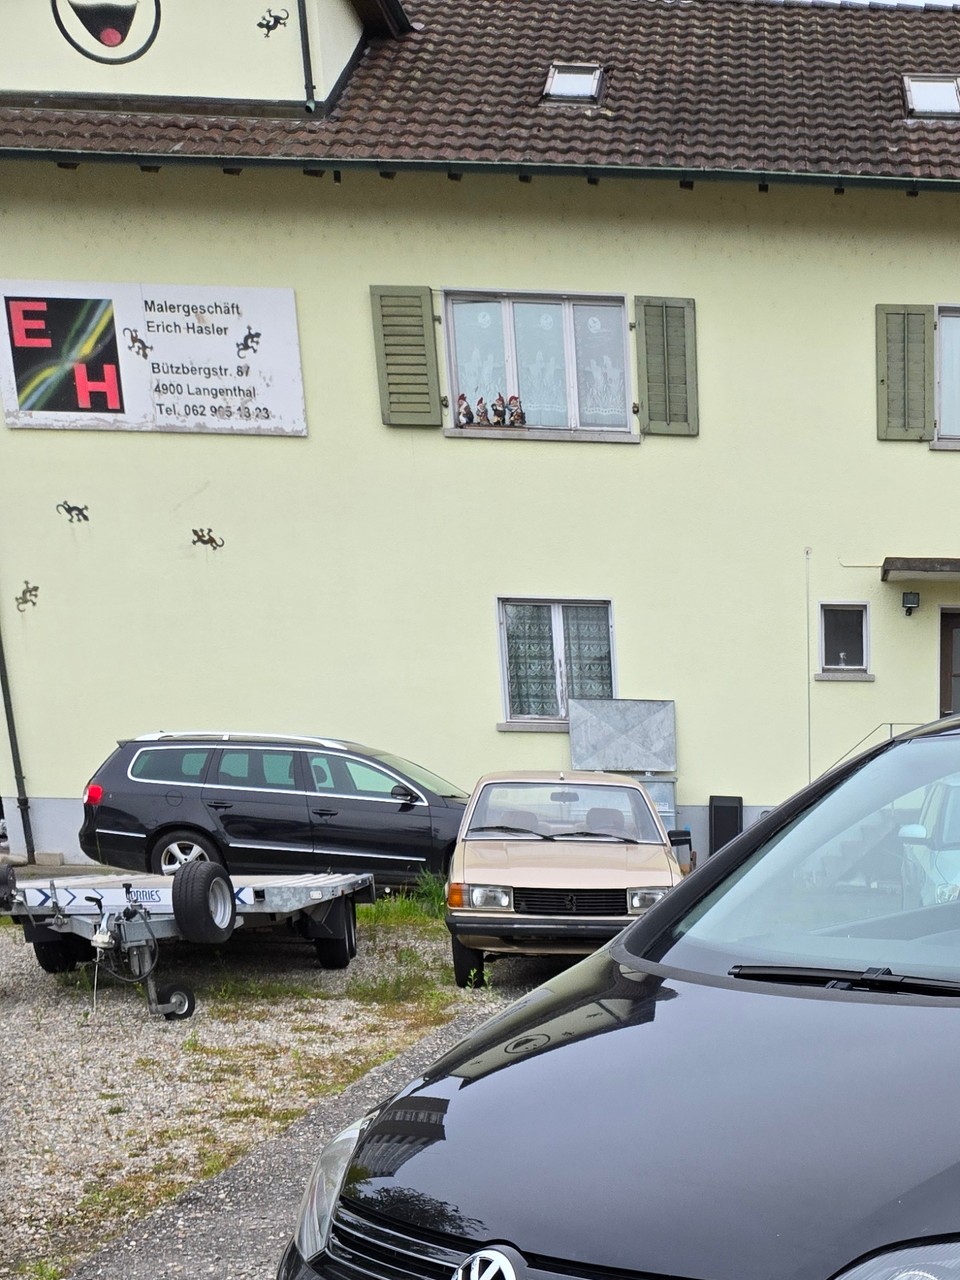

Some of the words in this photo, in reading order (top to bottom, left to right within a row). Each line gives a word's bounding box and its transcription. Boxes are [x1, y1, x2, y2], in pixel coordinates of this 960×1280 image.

[144, 300, 241, 317] Malergeschäft
[9, 301, 52, 347] E
[146, 320, 181, 333] Erich
[186, 322, 228, 336] Hasler
[151, 362, 232, 379] Bützbergstr.
[74, 363, 121, 409] H
[154, 383, 183, 395] 4900
[187, 384, 256, 399] Langenthal
[156, 403, 180, 416] Tel.
[184, 404, 206, 416] 062
[236, 407, 251, 418] 13
[254, 407, 270, 419] 23
[126, 889, 161, 902] ORRIES
